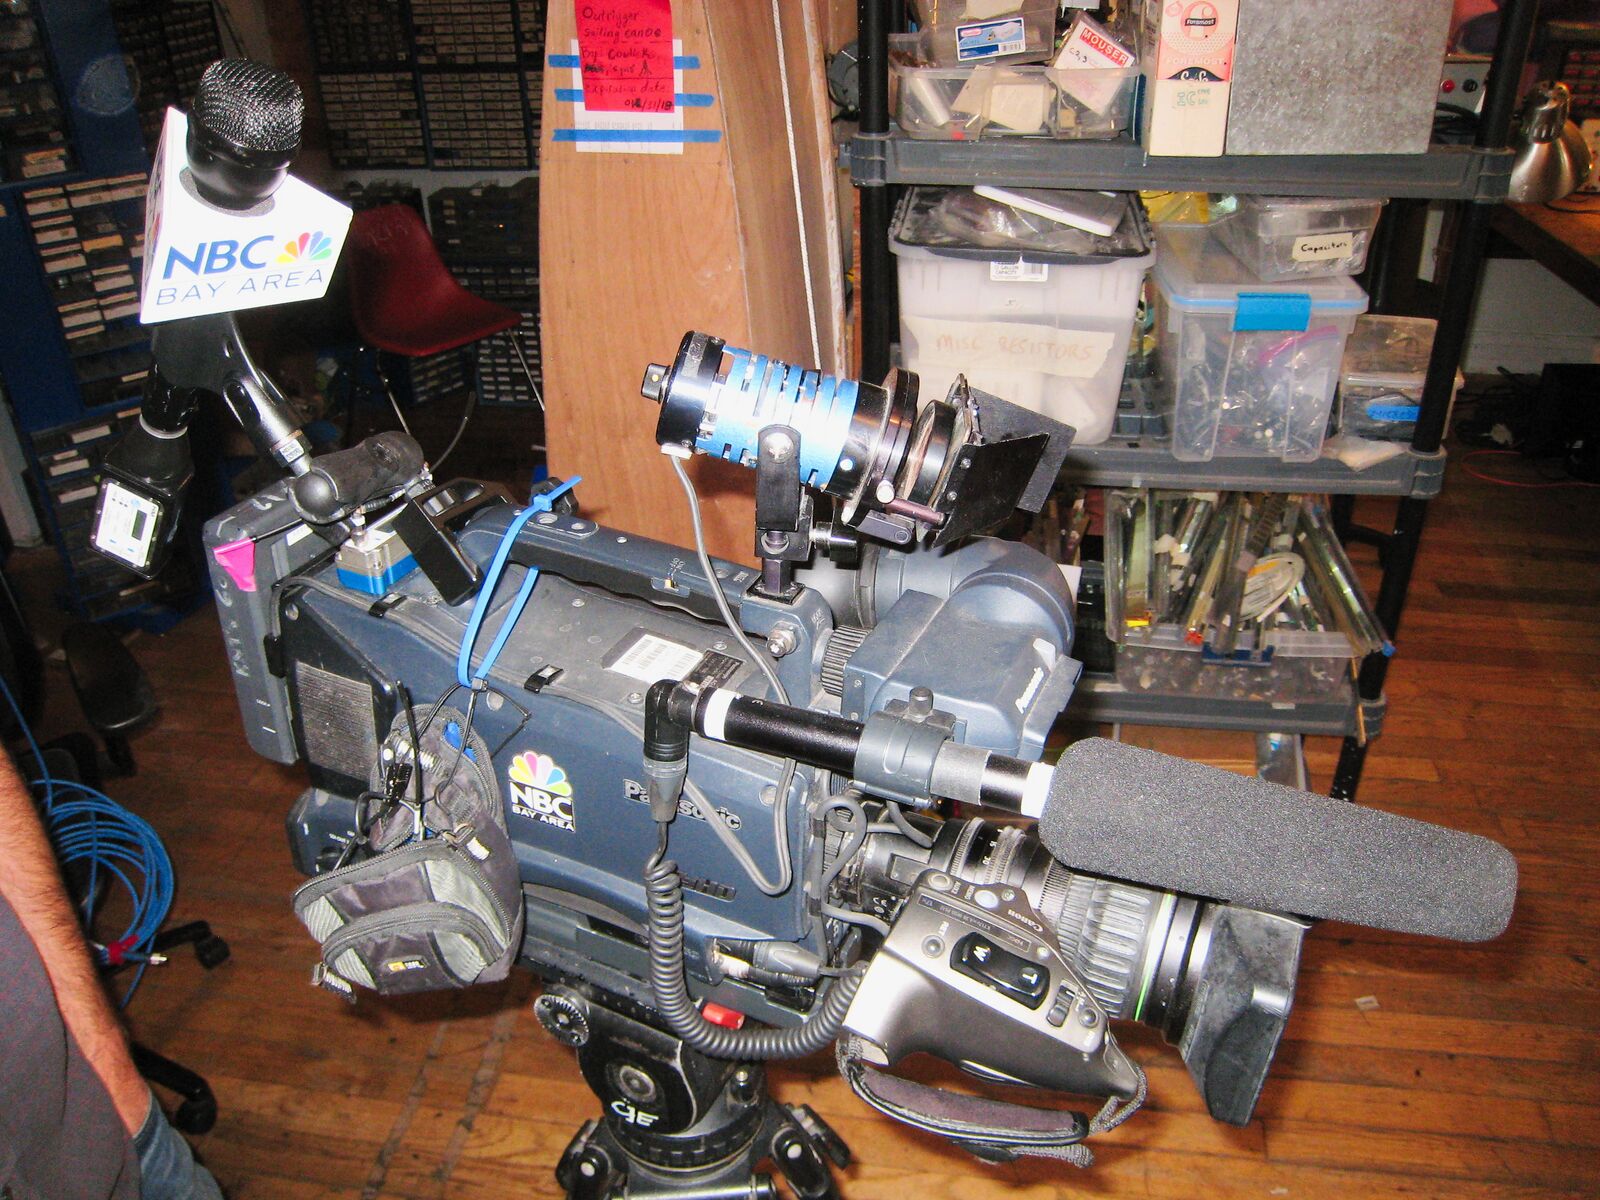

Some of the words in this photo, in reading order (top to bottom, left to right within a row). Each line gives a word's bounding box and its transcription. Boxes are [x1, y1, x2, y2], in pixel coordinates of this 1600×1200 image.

[582, 7, 639, 28] Outrigger
[1082, 28, 1128, 65] MOUSER
[162, 235, 275, 279] NBC
[156, 281, 226, 306] BAY
[236, 269, 323, 295] AREA
[936, 335, 983, 351] MISC
[998, 335, 1094, 361] RESISTORS
[509, 782, 573, 821] NBC
[512, 806, 537, 818] BAY
[540, 815, 575, 832] AREA
[1007, 908, 1044, 933] Canon
[972, 945, 990, 962] W
[1022, 971, 1038, 985] T
